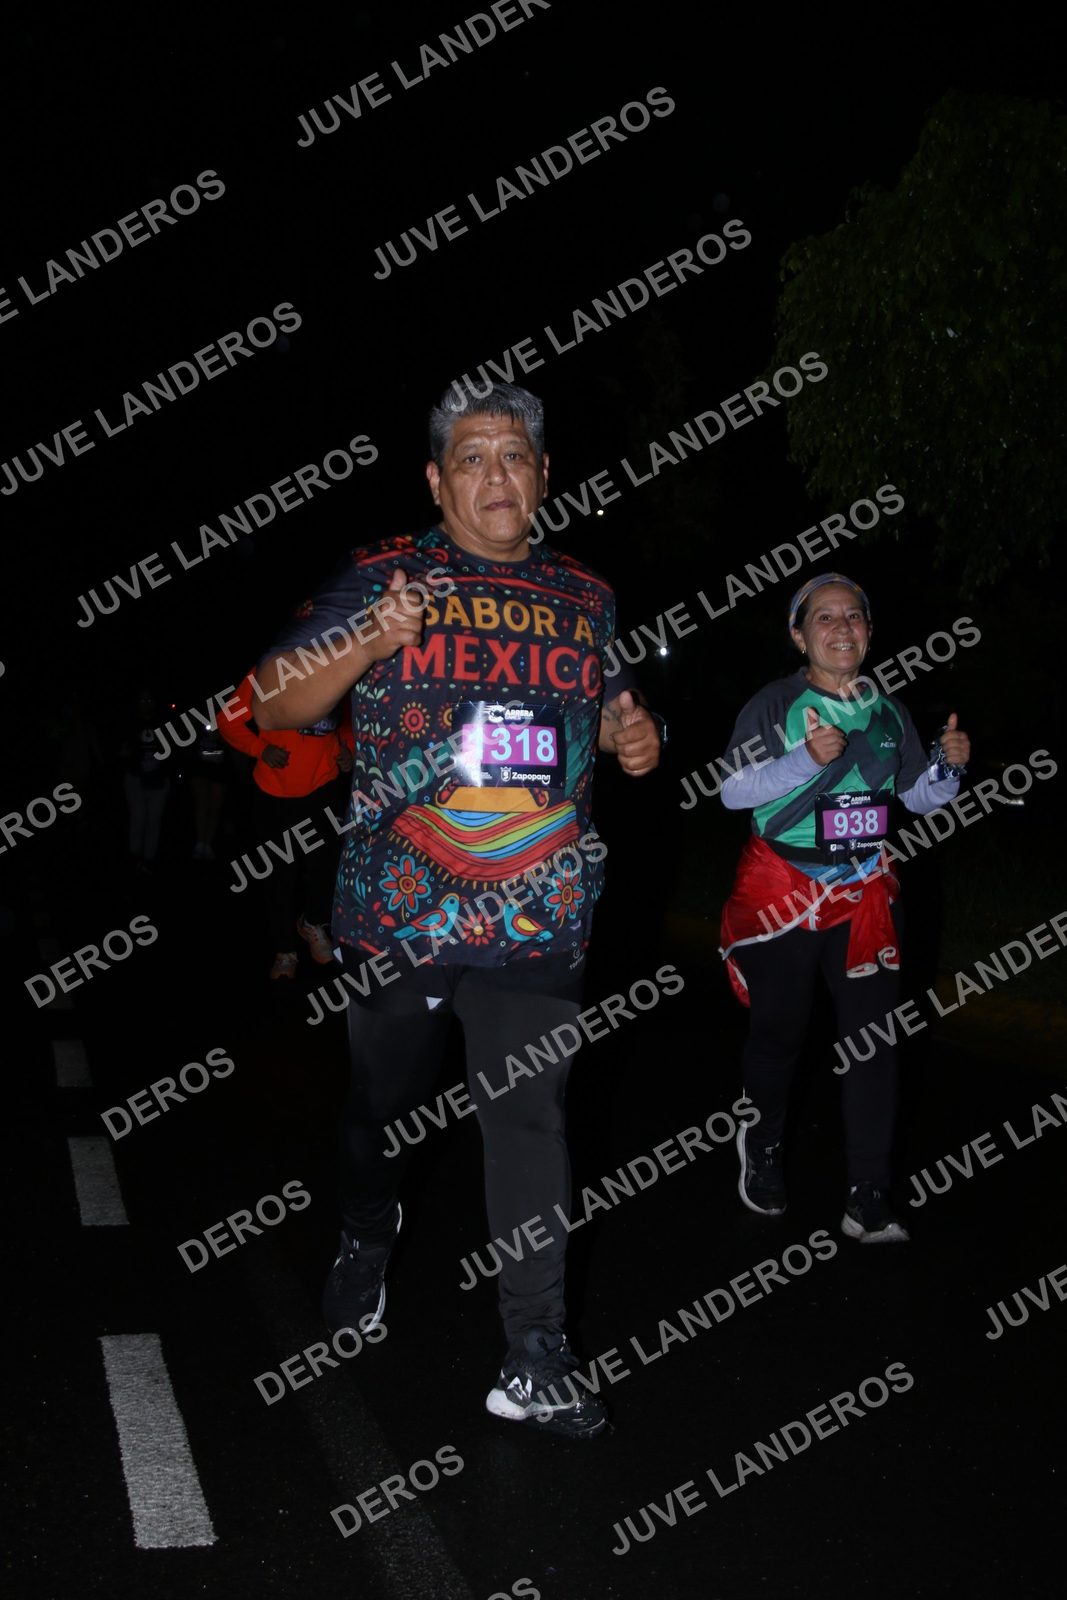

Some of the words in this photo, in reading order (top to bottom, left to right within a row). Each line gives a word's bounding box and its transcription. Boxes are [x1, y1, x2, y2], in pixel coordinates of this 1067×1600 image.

[425, 595, 559, 638] SABOR
[574, 615, 595, 647] A
[400, 630, 603, 698] MÉXICO
[468, 726, 555, 763] 1318
[833, 809, 879, 838] 938
